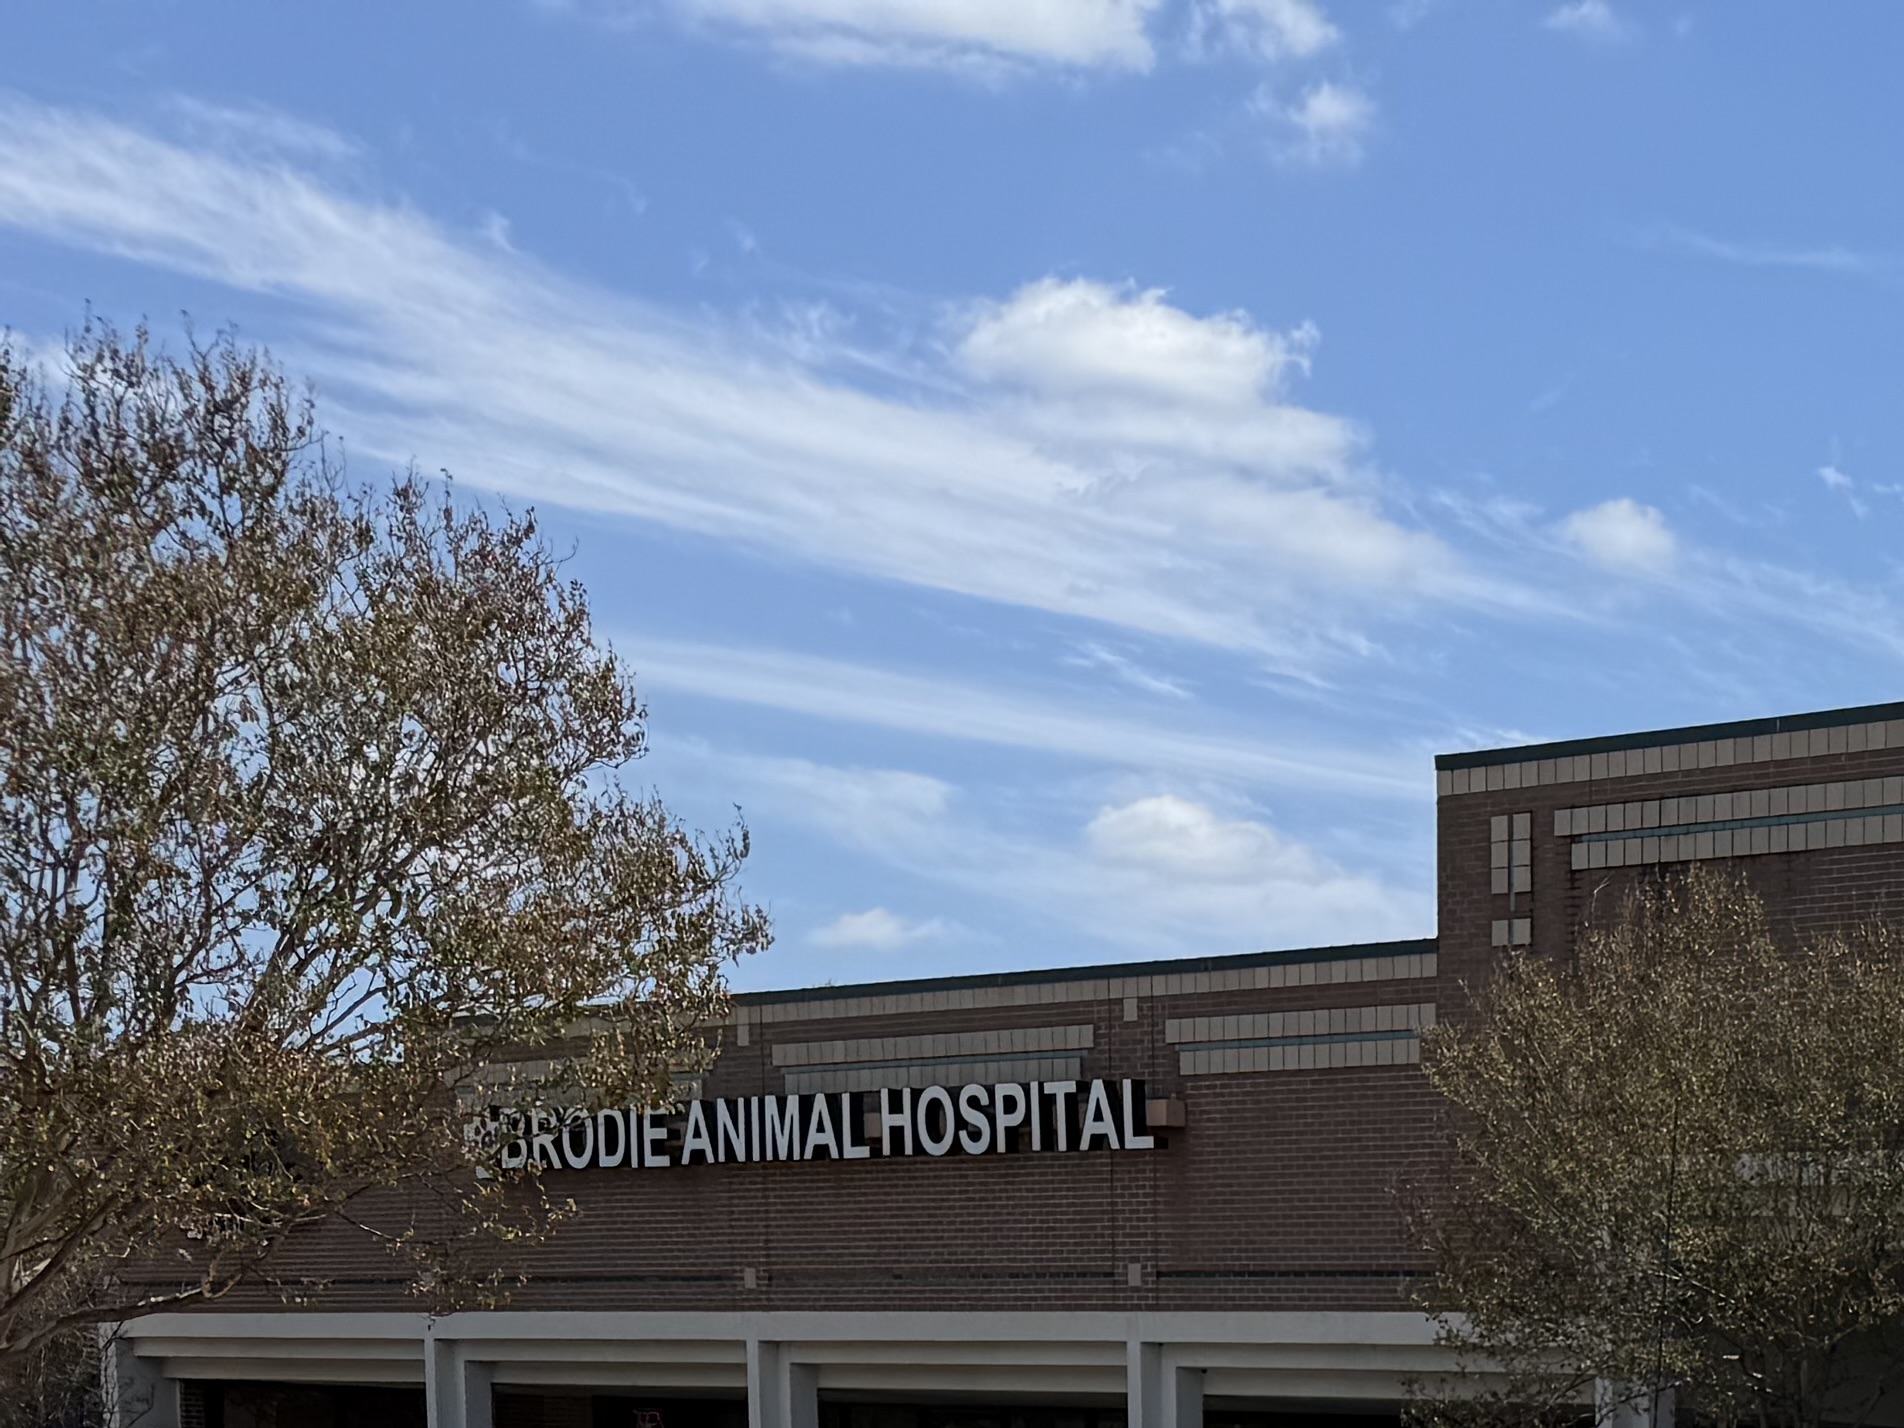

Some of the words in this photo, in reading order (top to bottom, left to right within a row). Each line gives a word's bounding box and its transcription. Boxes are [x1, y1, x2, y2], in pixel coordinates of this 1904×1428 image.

[500, 1105, 671, 1169] BRODIE
[682, 1093, 870, 1165] ANIMAL
[880, 1078, 1155, 1156] HOSPITAL
